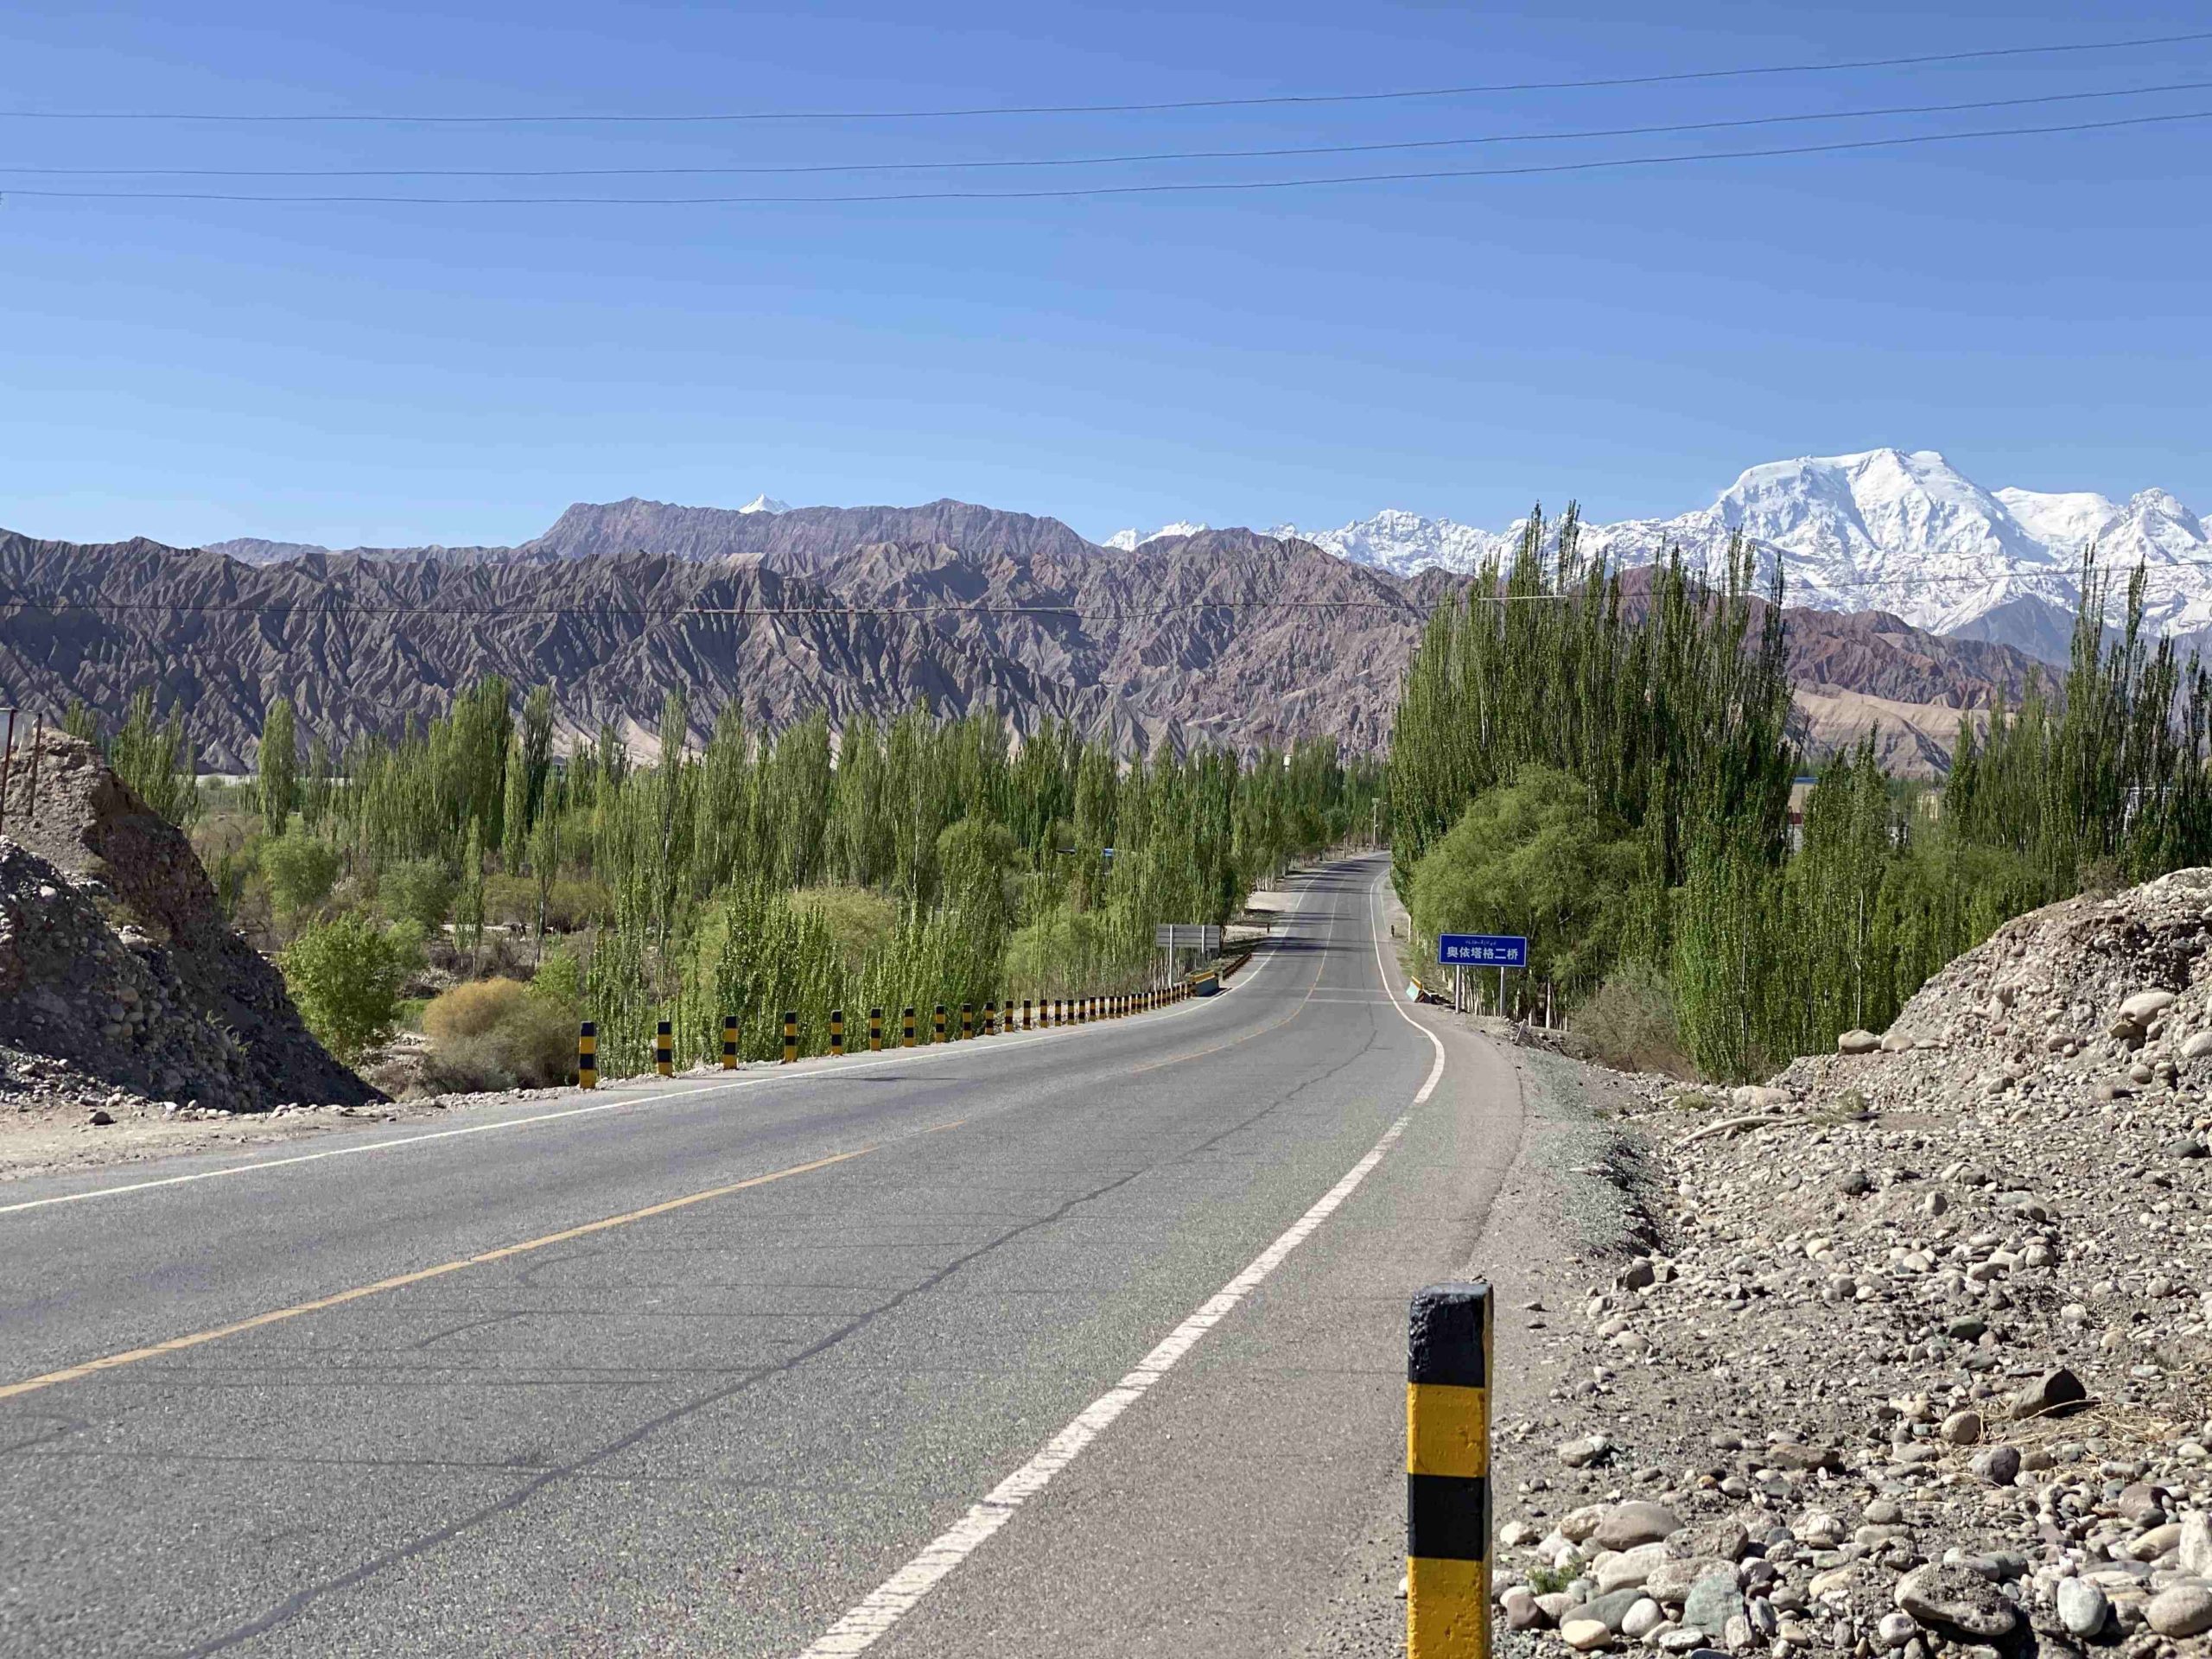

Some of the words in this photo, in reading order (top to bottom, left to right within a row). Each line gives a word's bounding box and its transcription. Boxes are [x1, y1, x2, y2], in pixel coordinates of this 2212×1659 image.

[1446, 946, 1518, 960] 奥依塔格二桥
